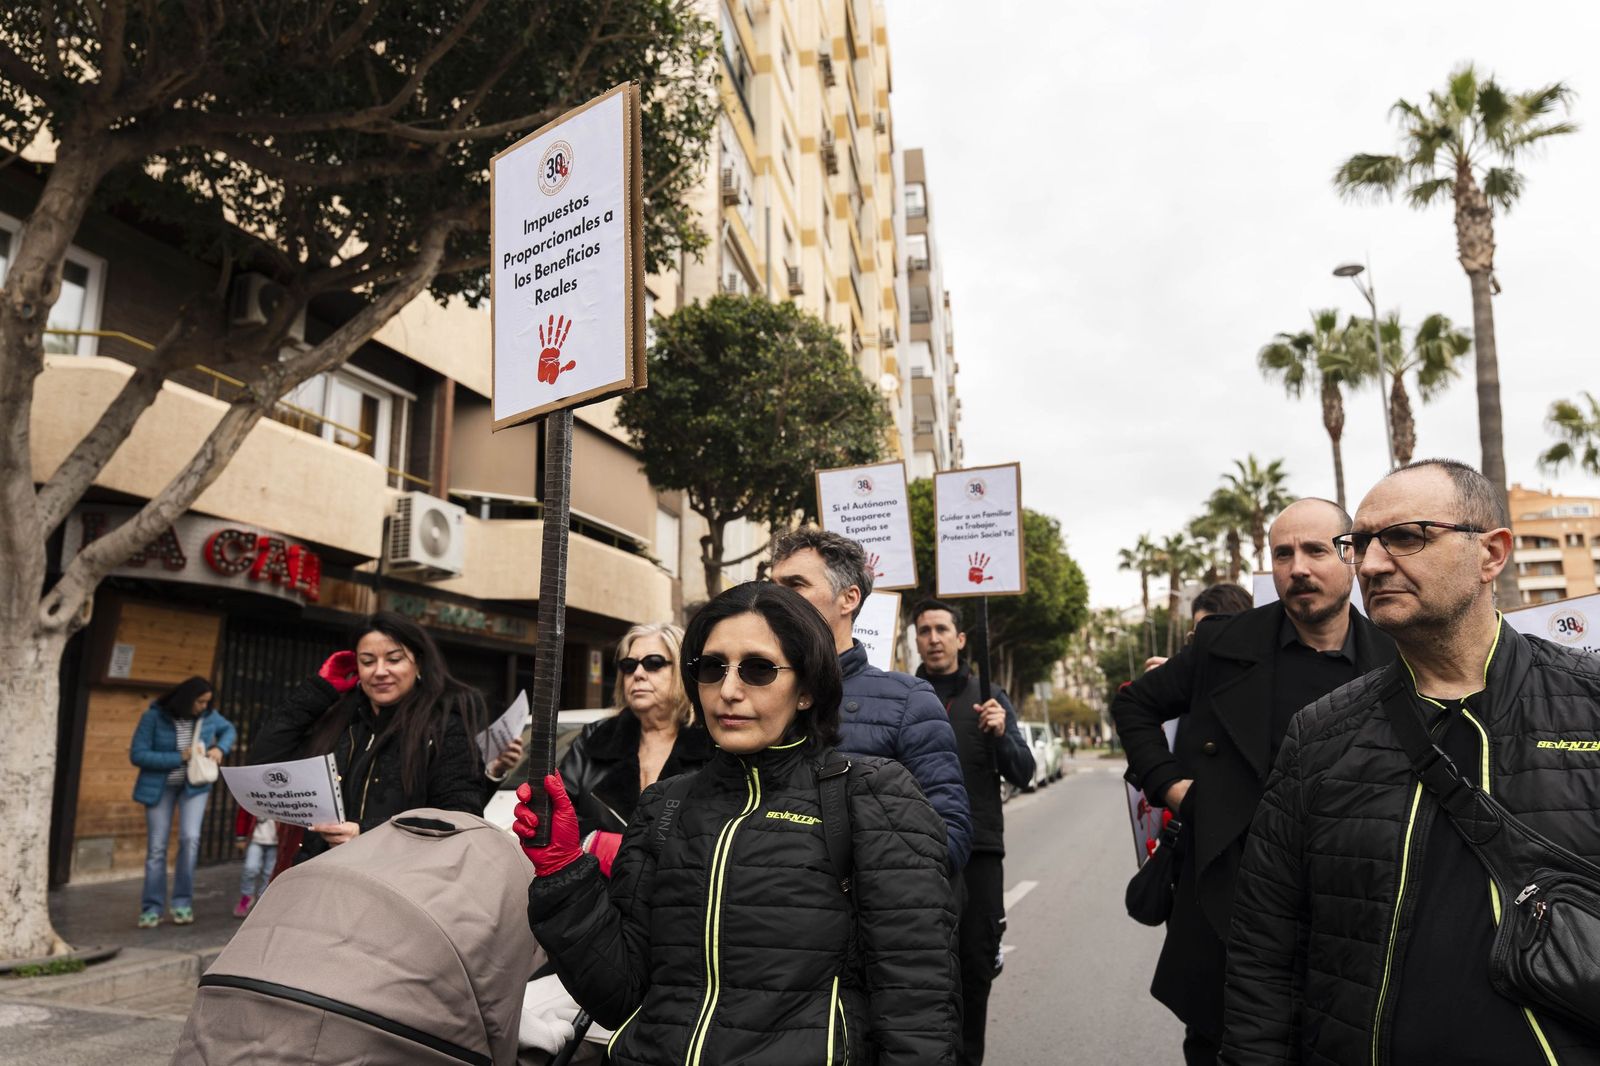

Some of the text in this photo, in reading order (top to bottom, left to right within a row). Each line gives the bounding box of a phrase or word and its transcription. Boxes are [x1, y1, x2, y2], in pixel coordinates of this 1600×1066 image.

[523, 195, 590, 235] Impuestos
[503, 210, 613, 269] Proporcionales a
[514, 242, 601, 289] los Beneficios
[535, 278, 578, 306] Reales
[832, 499, 898, 512] Si el Autónomo
[840, 511, 891, 523] Desaparece
[940, 513, 963, 522] Cuidar
[982, 509, 1012, 518] Familiar
[845, 524, 877, 534] España
[980, 530, 1001, 538] Social
[857, 535, 892, 544] vanece
[854, 624, 879, 636] imos
[250, 789, 317, 799] No Pedimos
[256, 800, 318, 811] Privilegios,
